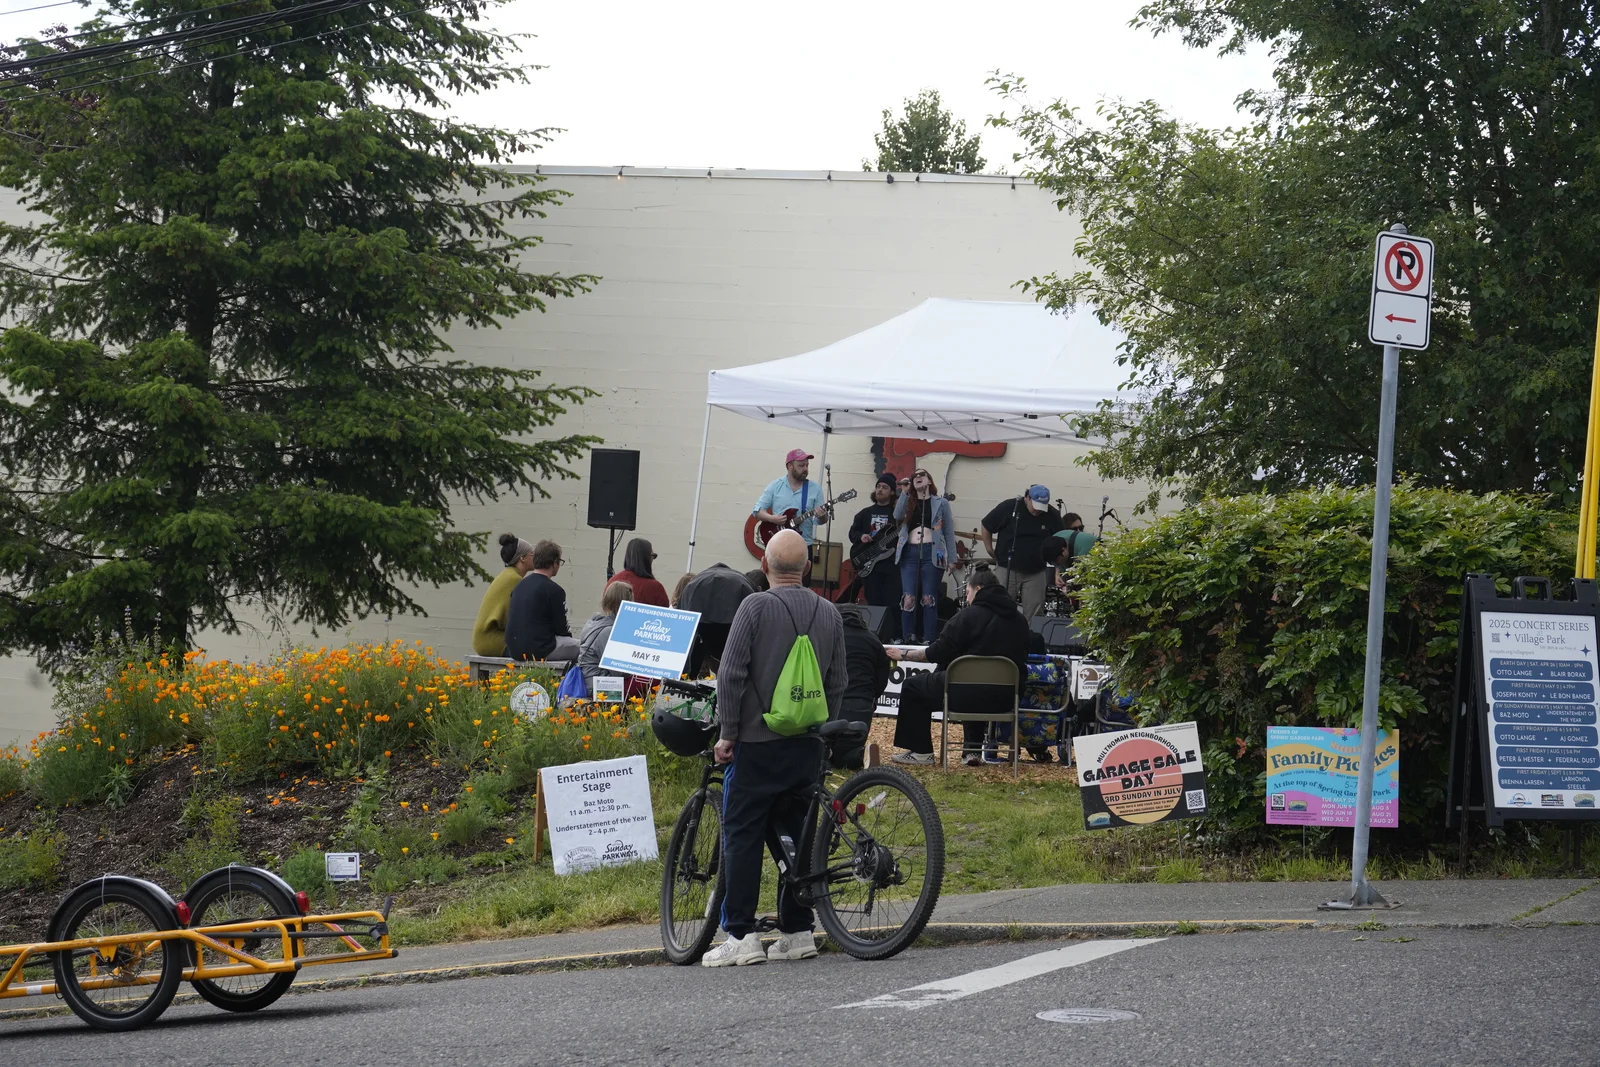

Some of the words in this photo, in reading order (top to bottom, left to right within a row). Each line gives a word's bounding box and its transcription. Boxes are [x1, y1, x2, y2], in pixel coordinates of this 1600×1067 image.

[637, 607, 678, 619] NEIGHBORHOOD
[640, 618, 671, 636] Sunday
[1489, 619, 1510, 629] 2025
[1512, 620, 1556, 630] CONCERT
[1558, 622, 1590, 632] SERIES
[634, 630, 672, 642] PARKWAYS
[1514, 634, 1544, 646] Village
[1546, 635, 1566, 644] Park
[632, 651, 650, 661] MAY
[1096, 734, 1129, 764] MULTNOMAH
[1130, 732, 1179, 755] NEIGHBORHOOD
[1083, 758, 1150, 783] GARAGE
[1153, 746, 1198, 768] SALE
[1271, 750, 1334, 772] Family
[1335, 745, 1396, 772] Picics
[557, 766, 633, 784] Entertainment
[1121, 772, 1154, 790] DAY
[582, 782, 611, 793] Stage
[1122, 792, 1151, 800] SUNDAY
[1164, 787, 1182, 795] JULY
[1318, 783, 1343, 797] Spring
[556, 821, 610, 832] Understatement
[605, 840, 633, 853] Sunday
[602, 850, 638, 860] PARKWAYS
